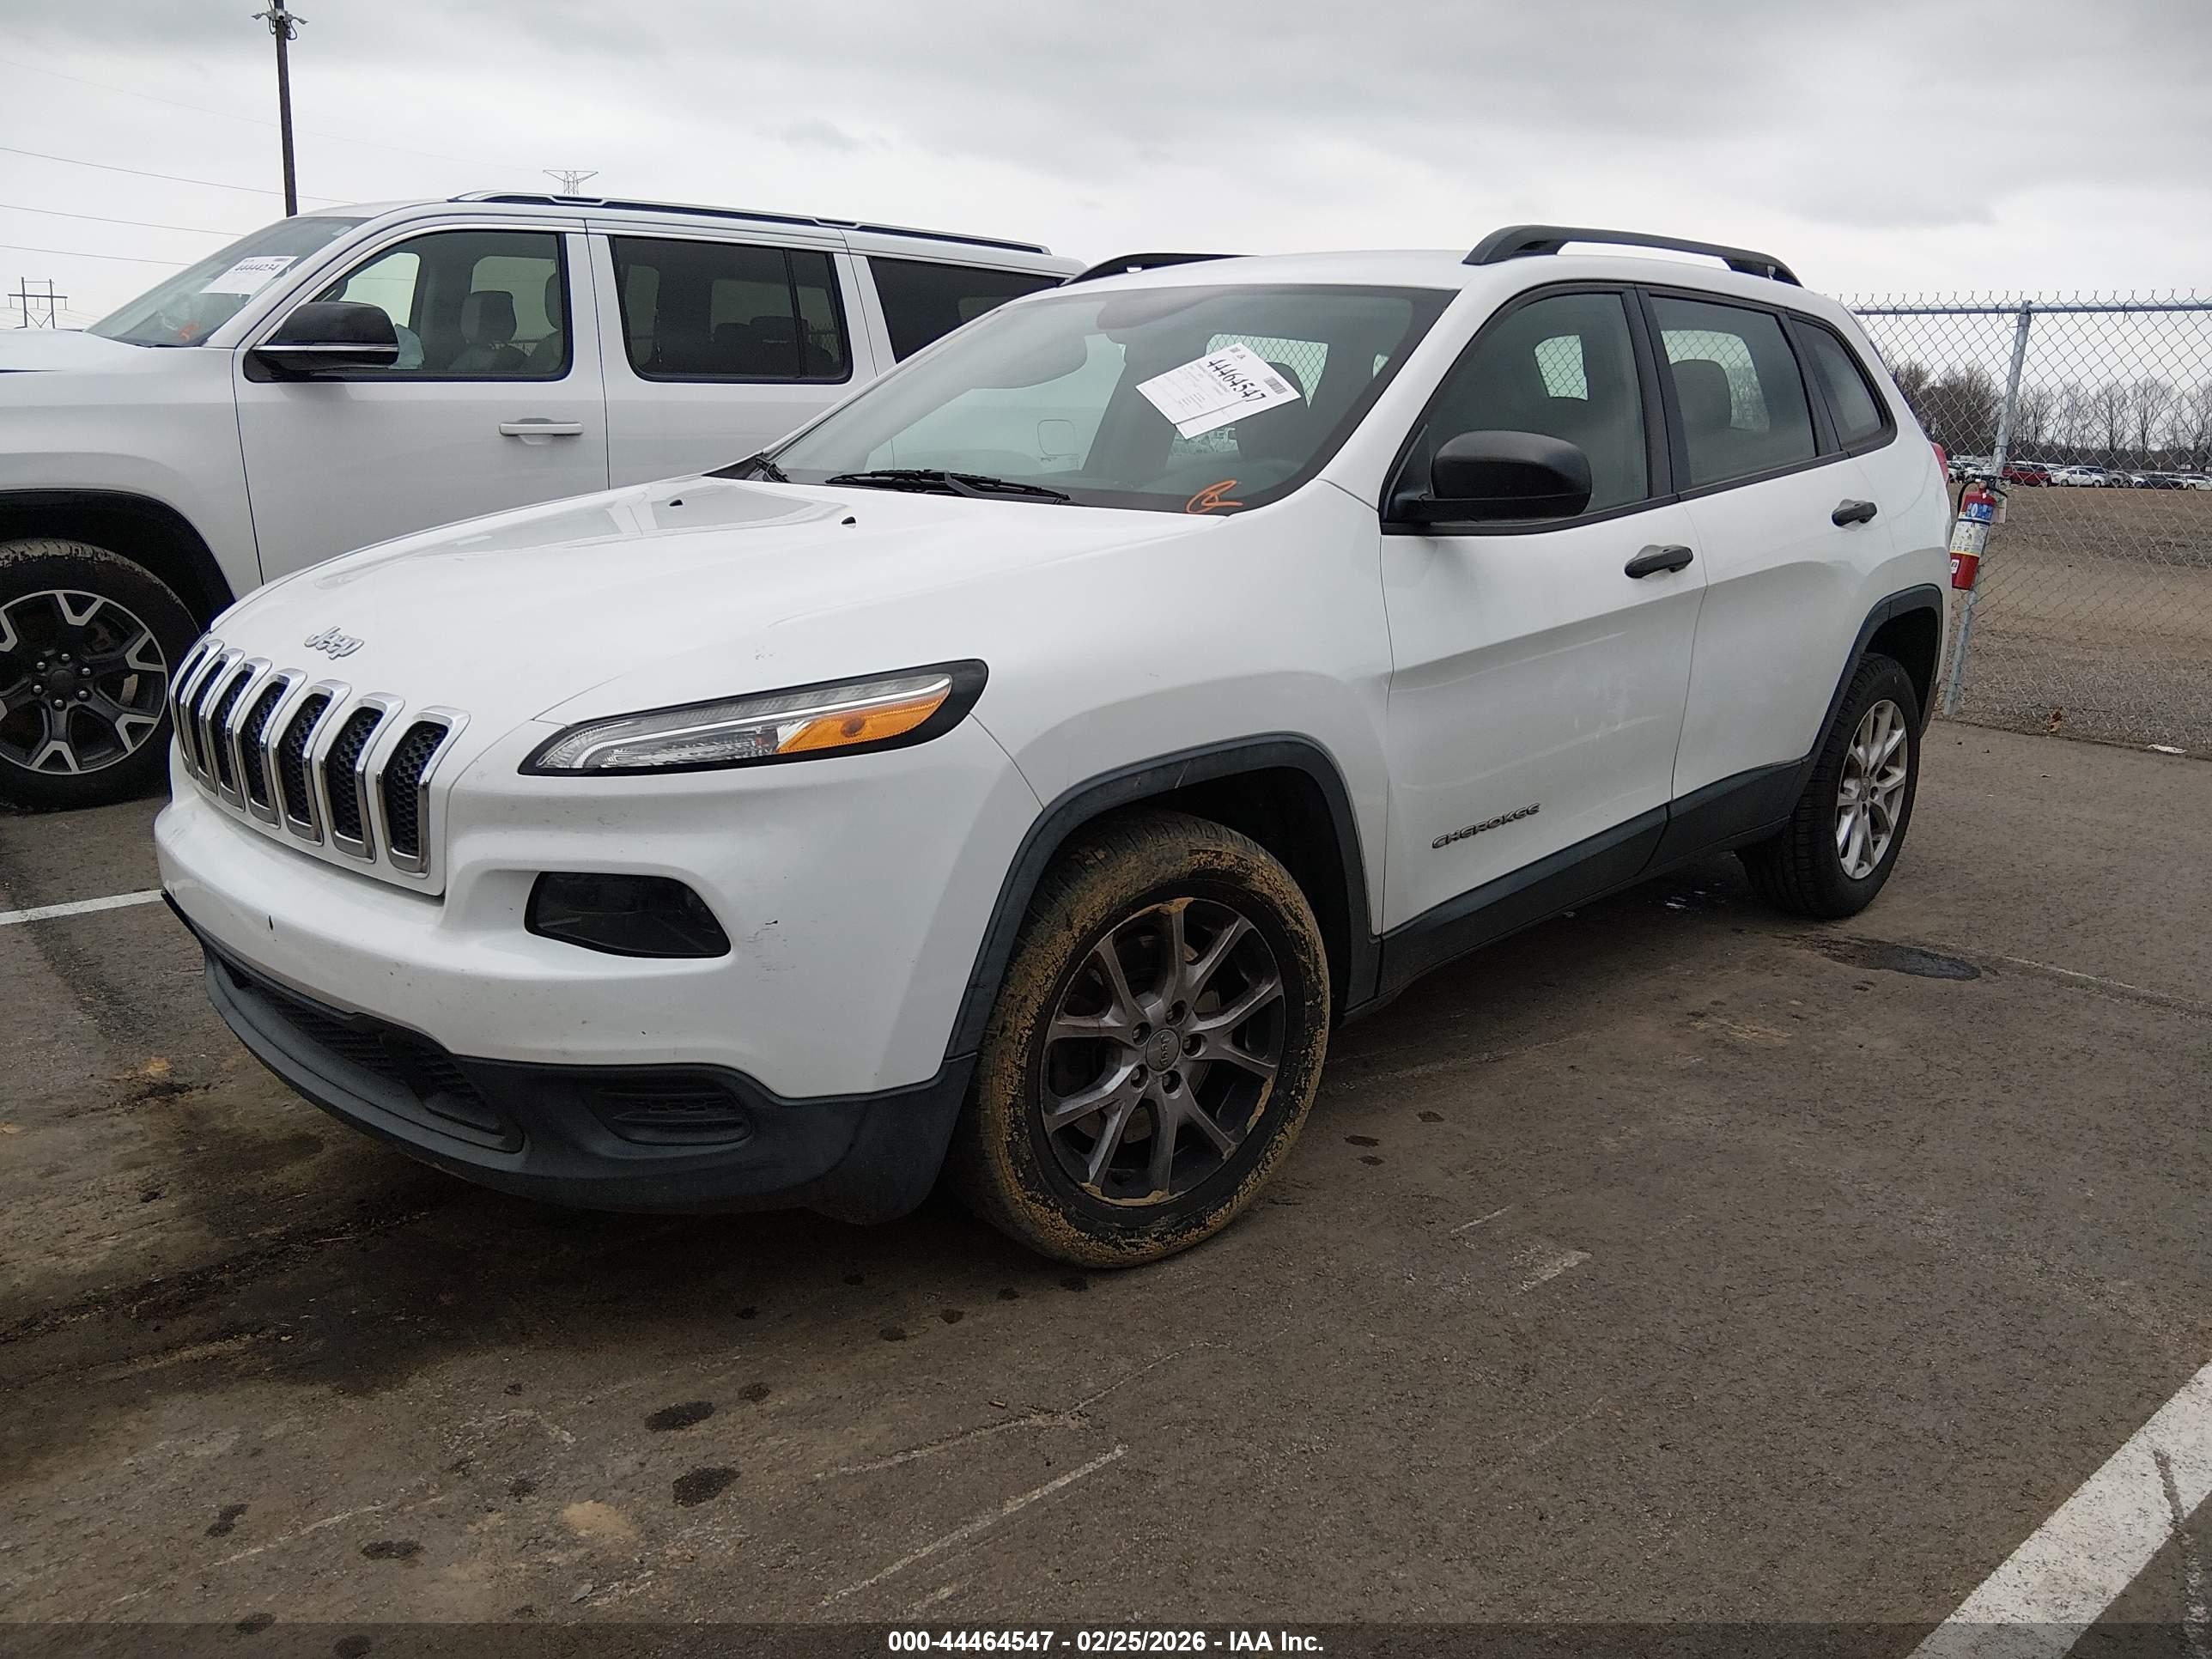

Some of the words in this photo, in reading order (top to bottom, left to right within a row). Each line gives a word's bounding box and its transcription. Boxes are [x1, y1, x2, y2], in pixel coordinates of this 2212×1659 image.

[1206, 358, 1267, 403] 44464547
[304, 626, 364, 660] Jeep
[1431, 802, 1540, 849] CHEROKEE
[1159, 1033, 1170, 1066] Jeep
